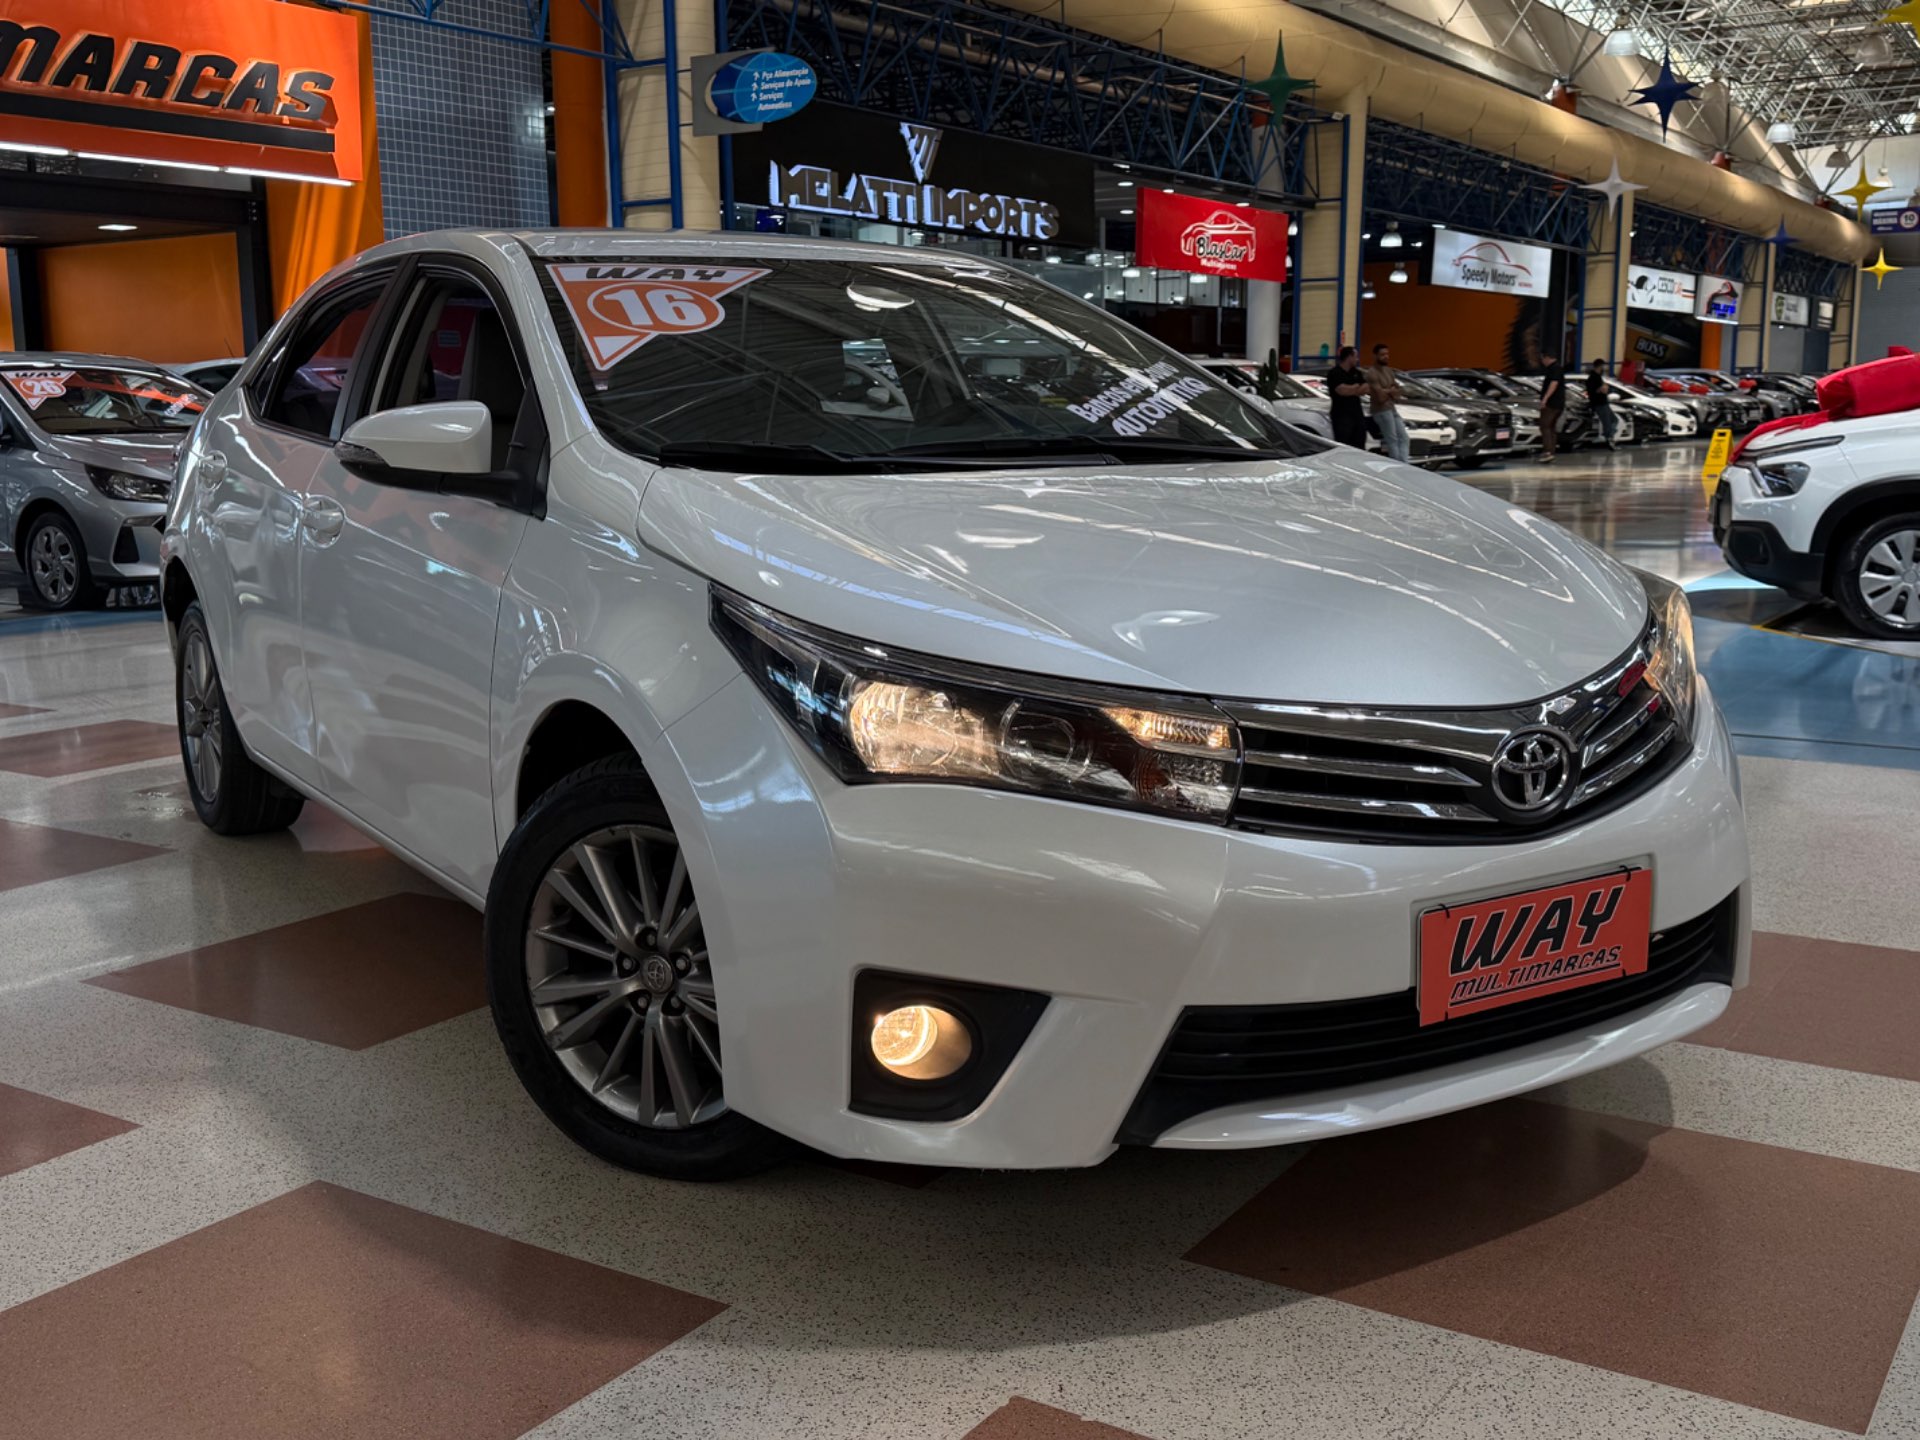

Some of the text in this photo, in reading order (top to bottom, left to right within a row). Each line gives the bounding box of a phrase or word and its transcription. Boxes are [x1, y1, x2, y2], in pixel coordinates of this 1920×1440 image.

[769, 160, 1060, 240] MELATTI IMPORTS
[585, 266, 727, 281] WAY
[1461, 264, 1518, 288] Speedy Motors
[603, 289, 707, 326] 16
[1066, 384, 1134, 424] Bancos
[1450, 885, 1625, 976] WAY
[1450, 945, 1623, 1000] MULTIMARCAS
